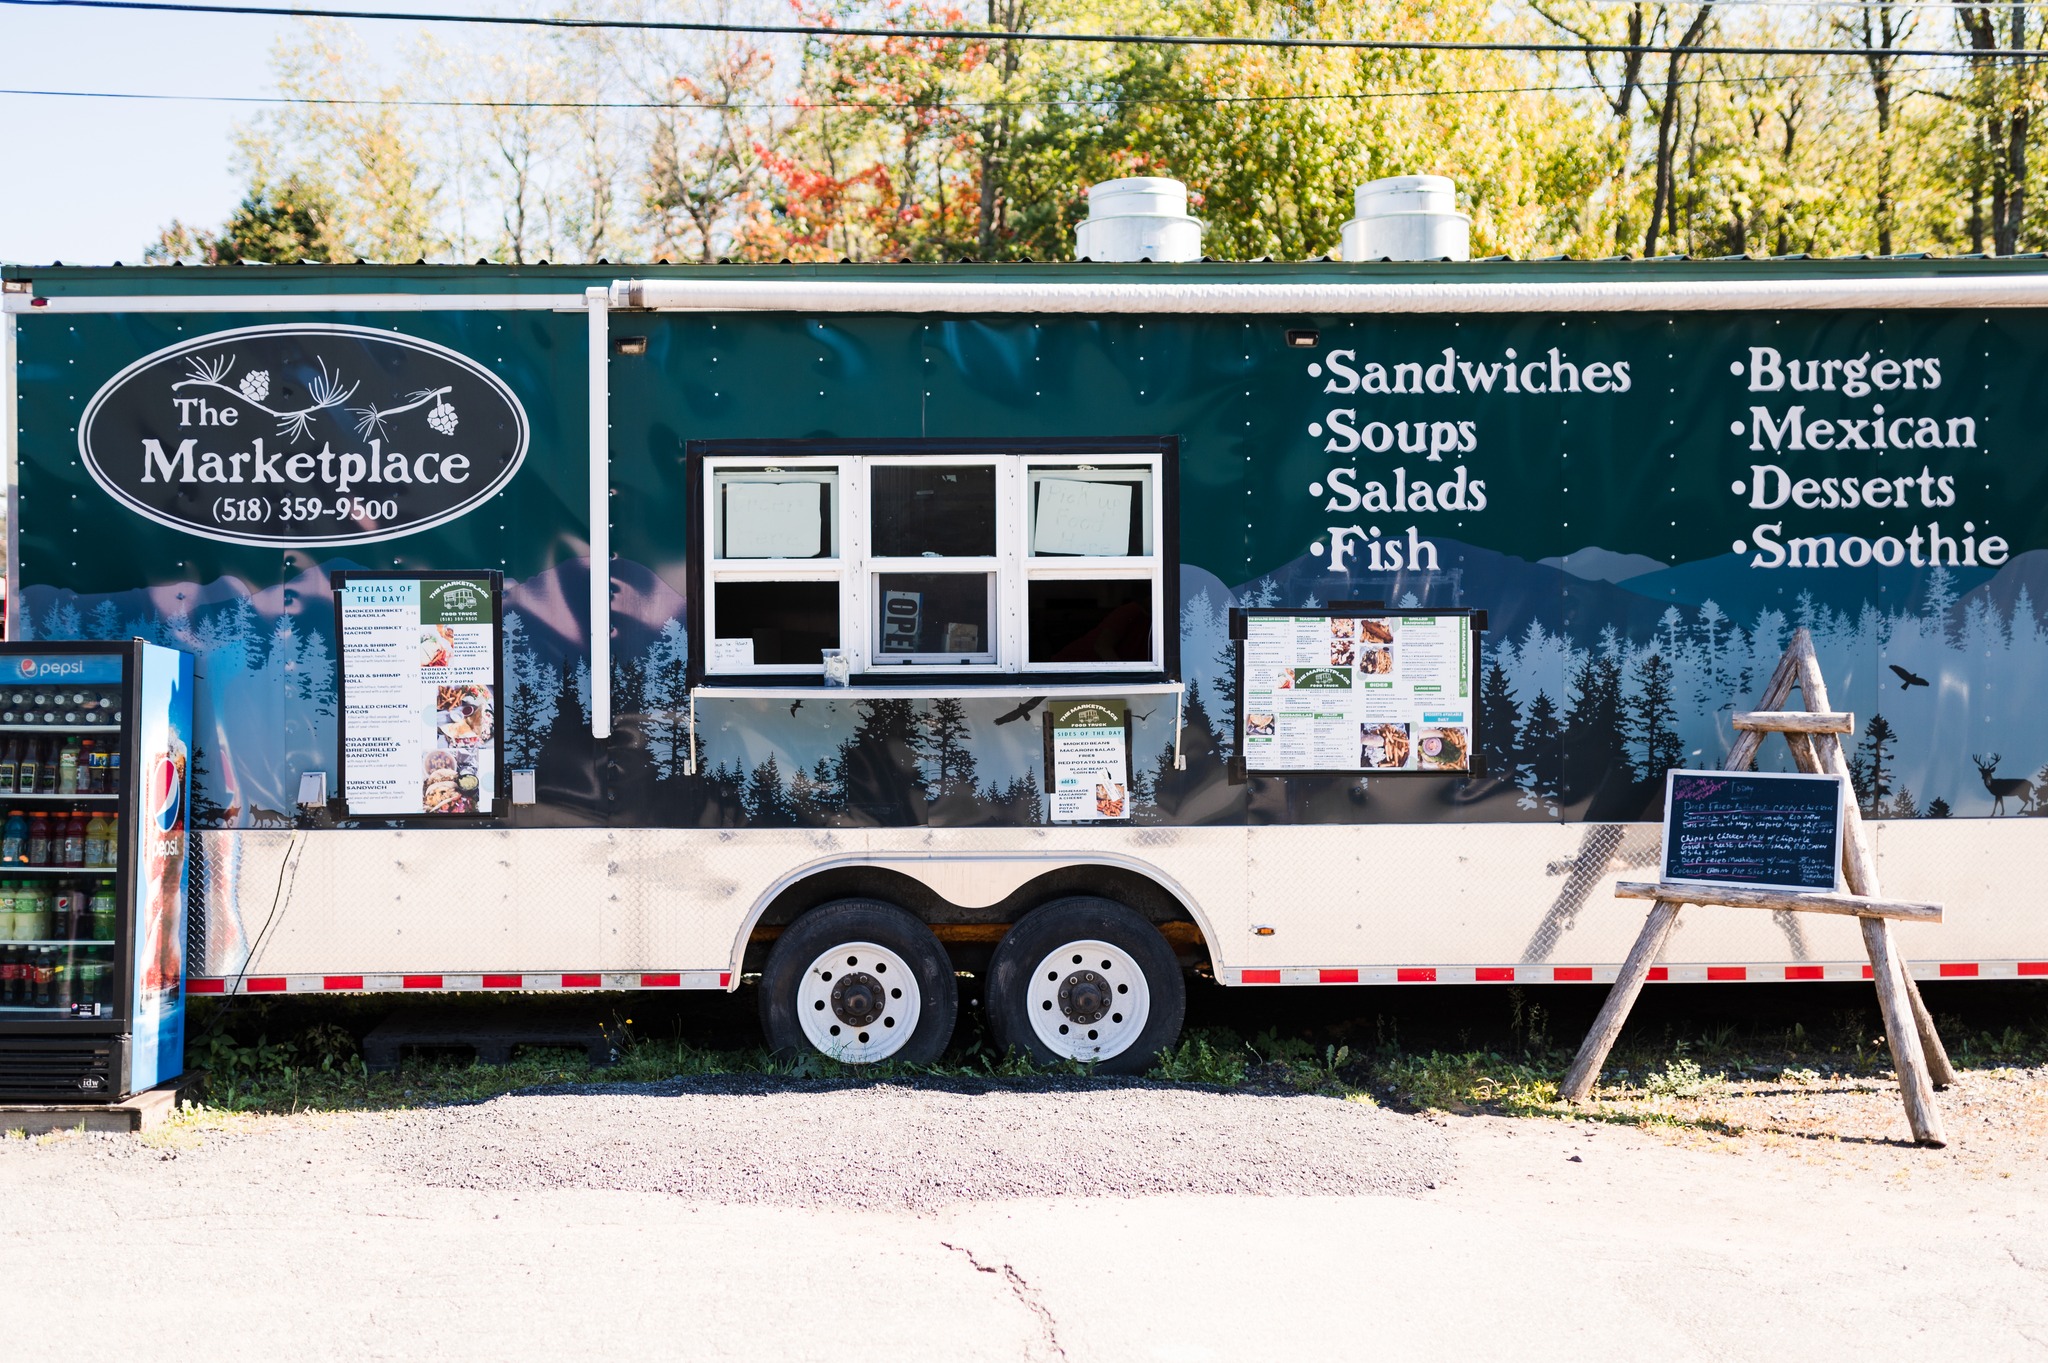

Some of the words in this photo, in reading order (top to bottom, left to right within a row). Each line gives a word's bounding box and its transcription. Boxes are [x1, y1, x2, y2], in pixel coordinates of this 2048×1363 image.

[1323, 347, 1632, 395] Sandwiches
[1749, 346, 1942, 397] Burgers
[172, 397, 238, 427] The
[1324, 409, 1477, 461] Soups
[1749, 404, 1977, 452] Mexican
[140, 438, 470, 492] Marketplace
[1749, 465, 1956, 510] Desserts
[212, 496, 271, 523] (518)
[278, 497, 397, 521] 359-9500
[1325, 467, 1487, 514] Salads
[1327, 526, 1440, 573] Fish
[1750, 520, 2010, 569] Smoothie
[346, 585, 393, 593] SPECIALS
[382, 595, 405, 603] DAY!
[440, 580, 490, 600] MARKETPLACE
[885, 598, 918, 653] OPE
[40, 659, 84, 677] pepsi
[1306, 668, 1351, 685] MARKETPLACE
[1060, 711, 1072, 722] THE
[1070, 704, 1119, 722] MARKETPLACE
